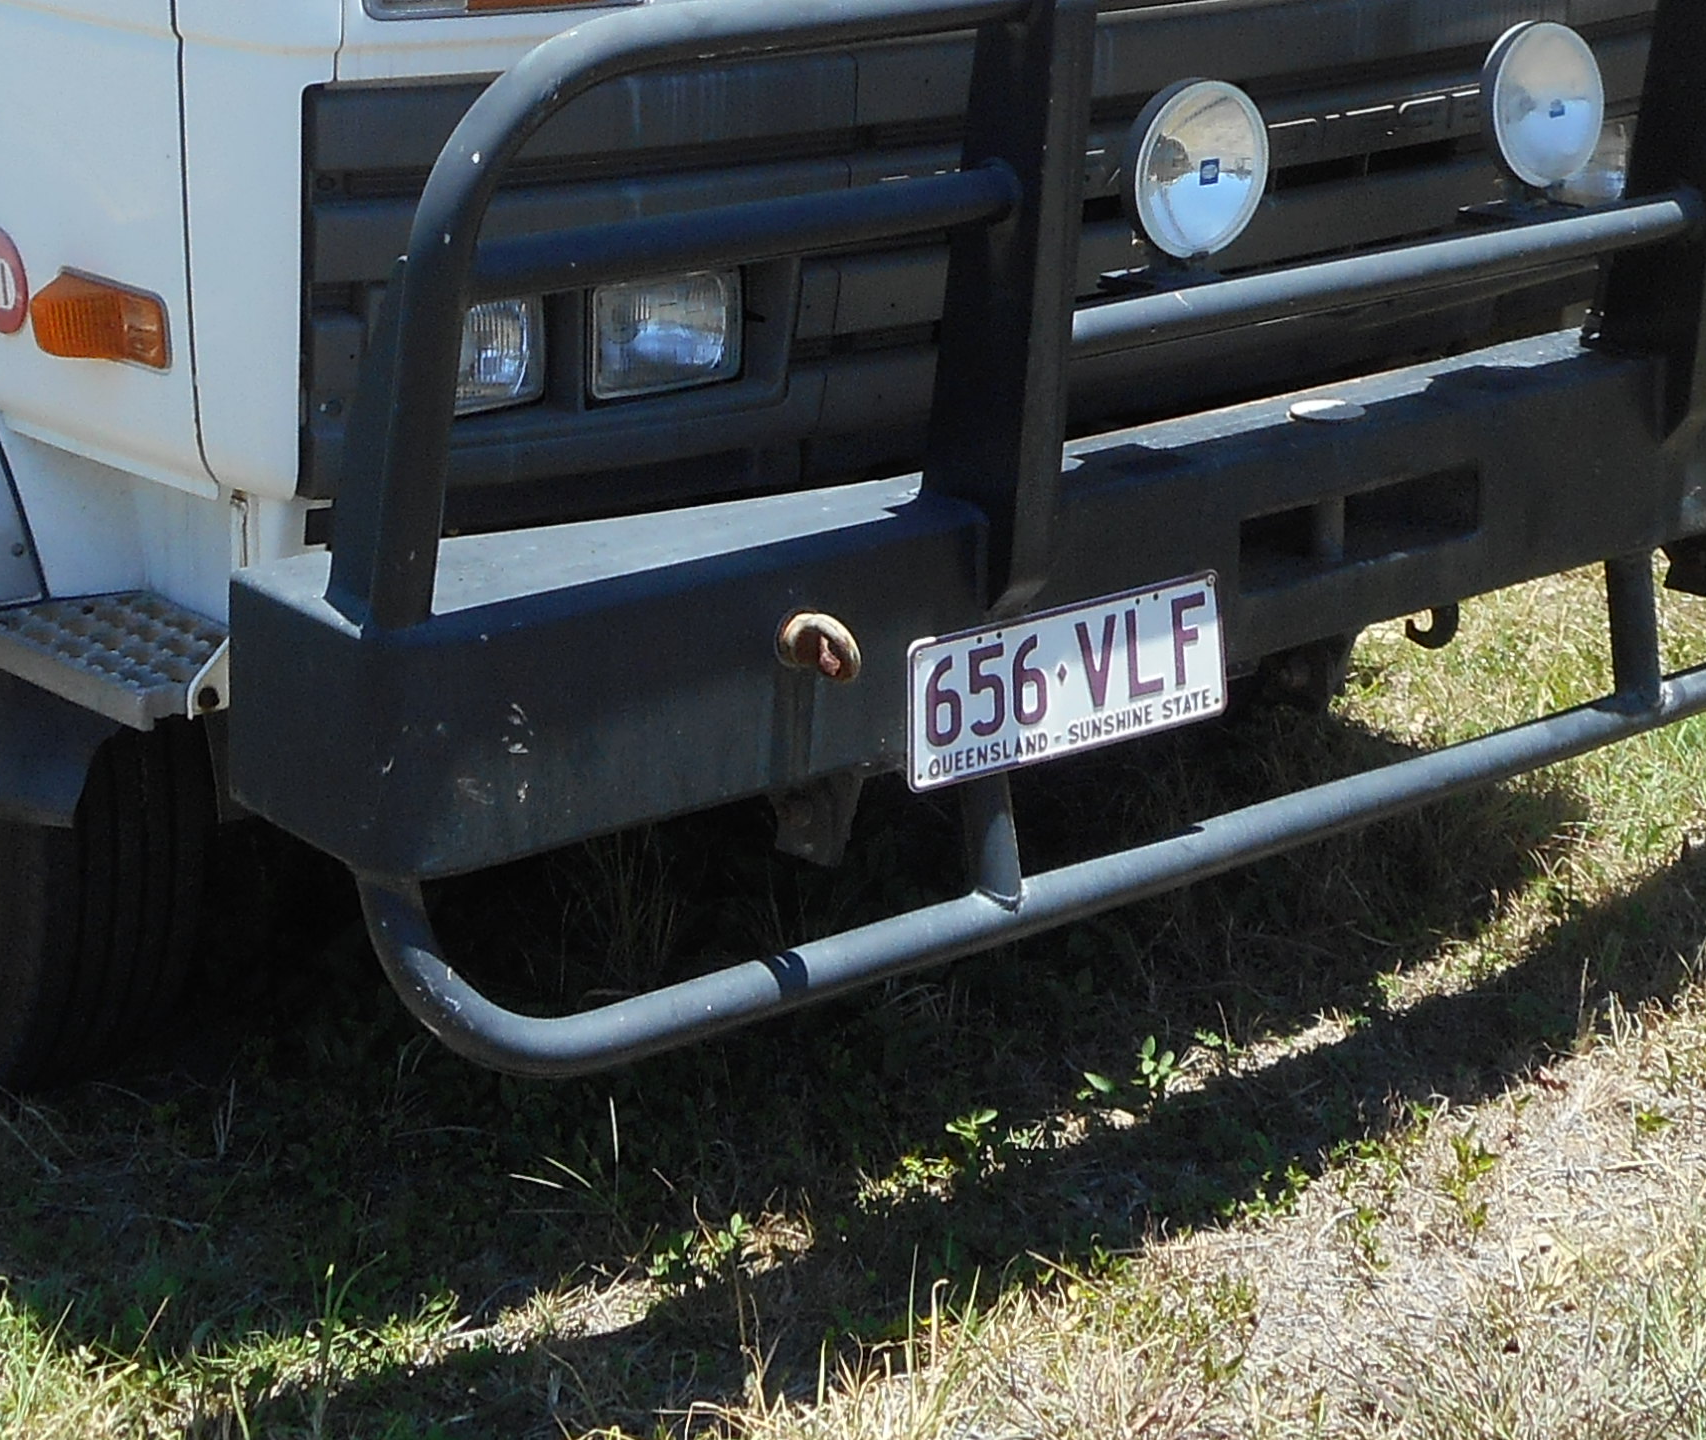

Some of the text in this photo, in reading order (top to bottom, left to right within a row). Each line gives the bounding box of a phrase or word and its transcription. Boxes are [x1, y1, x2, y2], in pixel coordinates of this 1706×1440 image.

[928, 731, 1049, 779] QUEENSLAND
[1067, 703, 1154, 744] SUNSHINE
[1161, 687, 1212, 721] STATE
